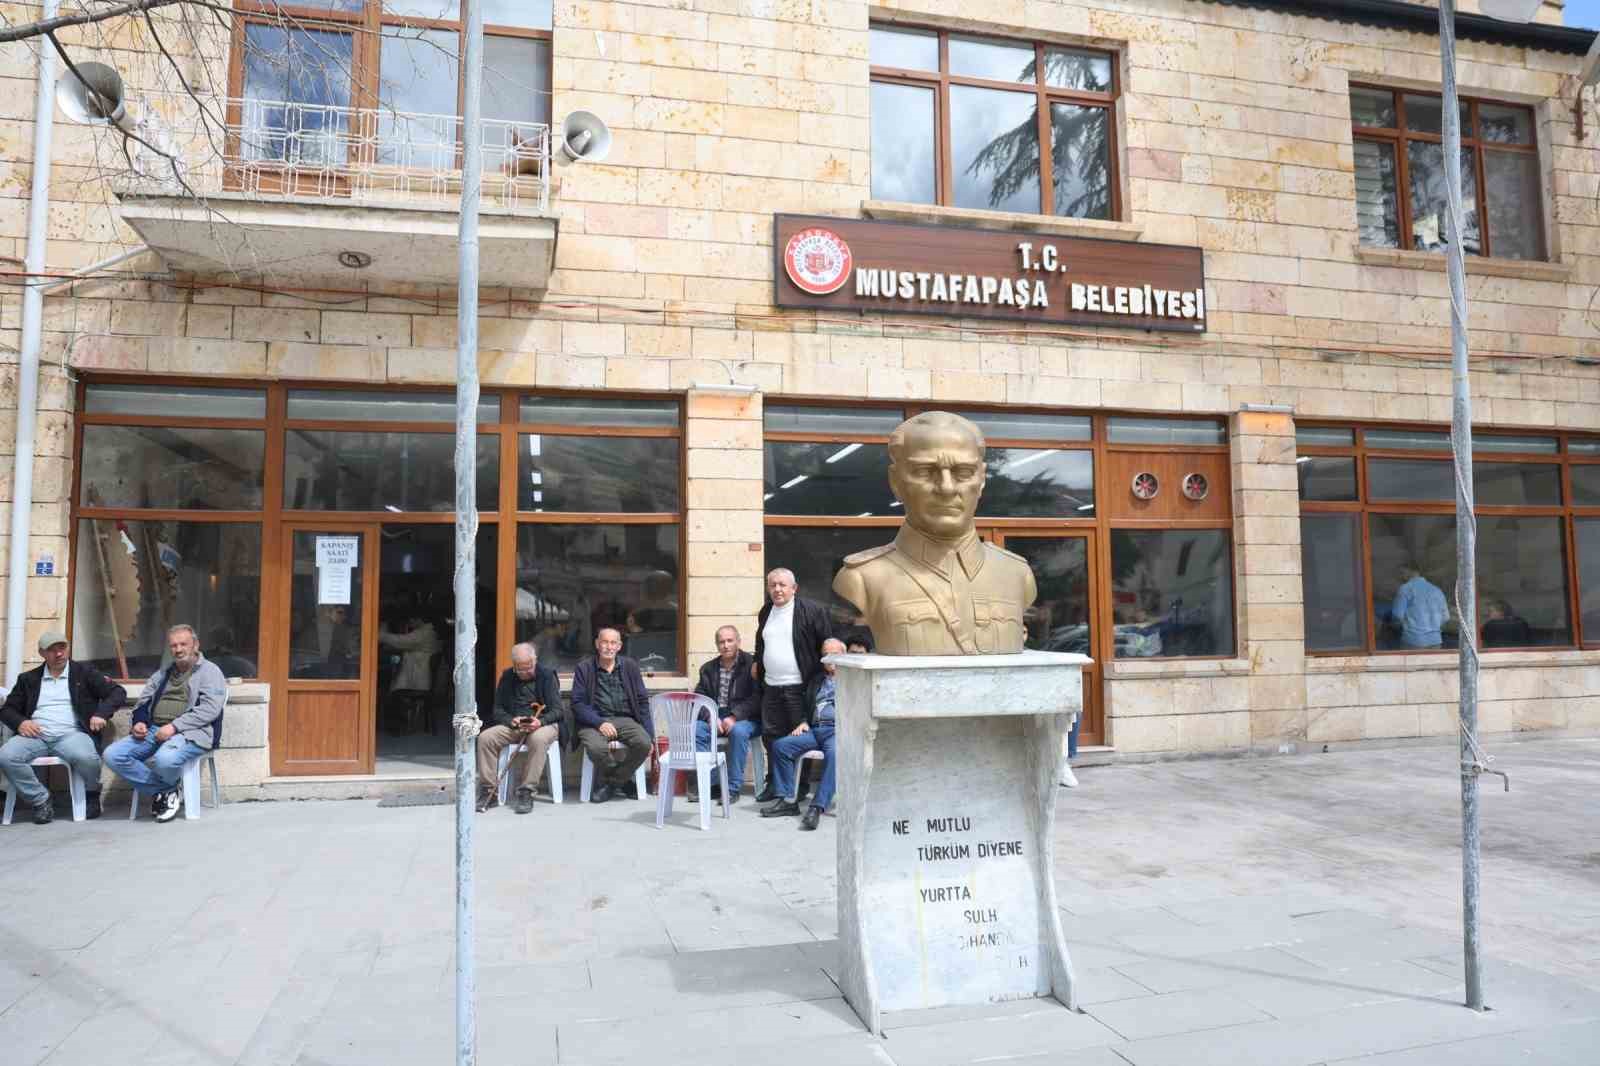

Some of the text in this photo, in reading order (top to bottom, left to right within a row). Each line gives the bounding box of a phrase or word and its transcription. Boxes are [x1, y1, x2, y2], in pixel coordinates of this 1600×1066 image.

[1018, 242, 1066, 273] T.C.
[855, 267, 1204, 319] MUSTAFAPAŞA BELEDİYESİ
[893, 817, 971, 835] NE MUTLU
[920, 886, 972, 903] YURTTA
[963, 908, 998, 924] SULH
